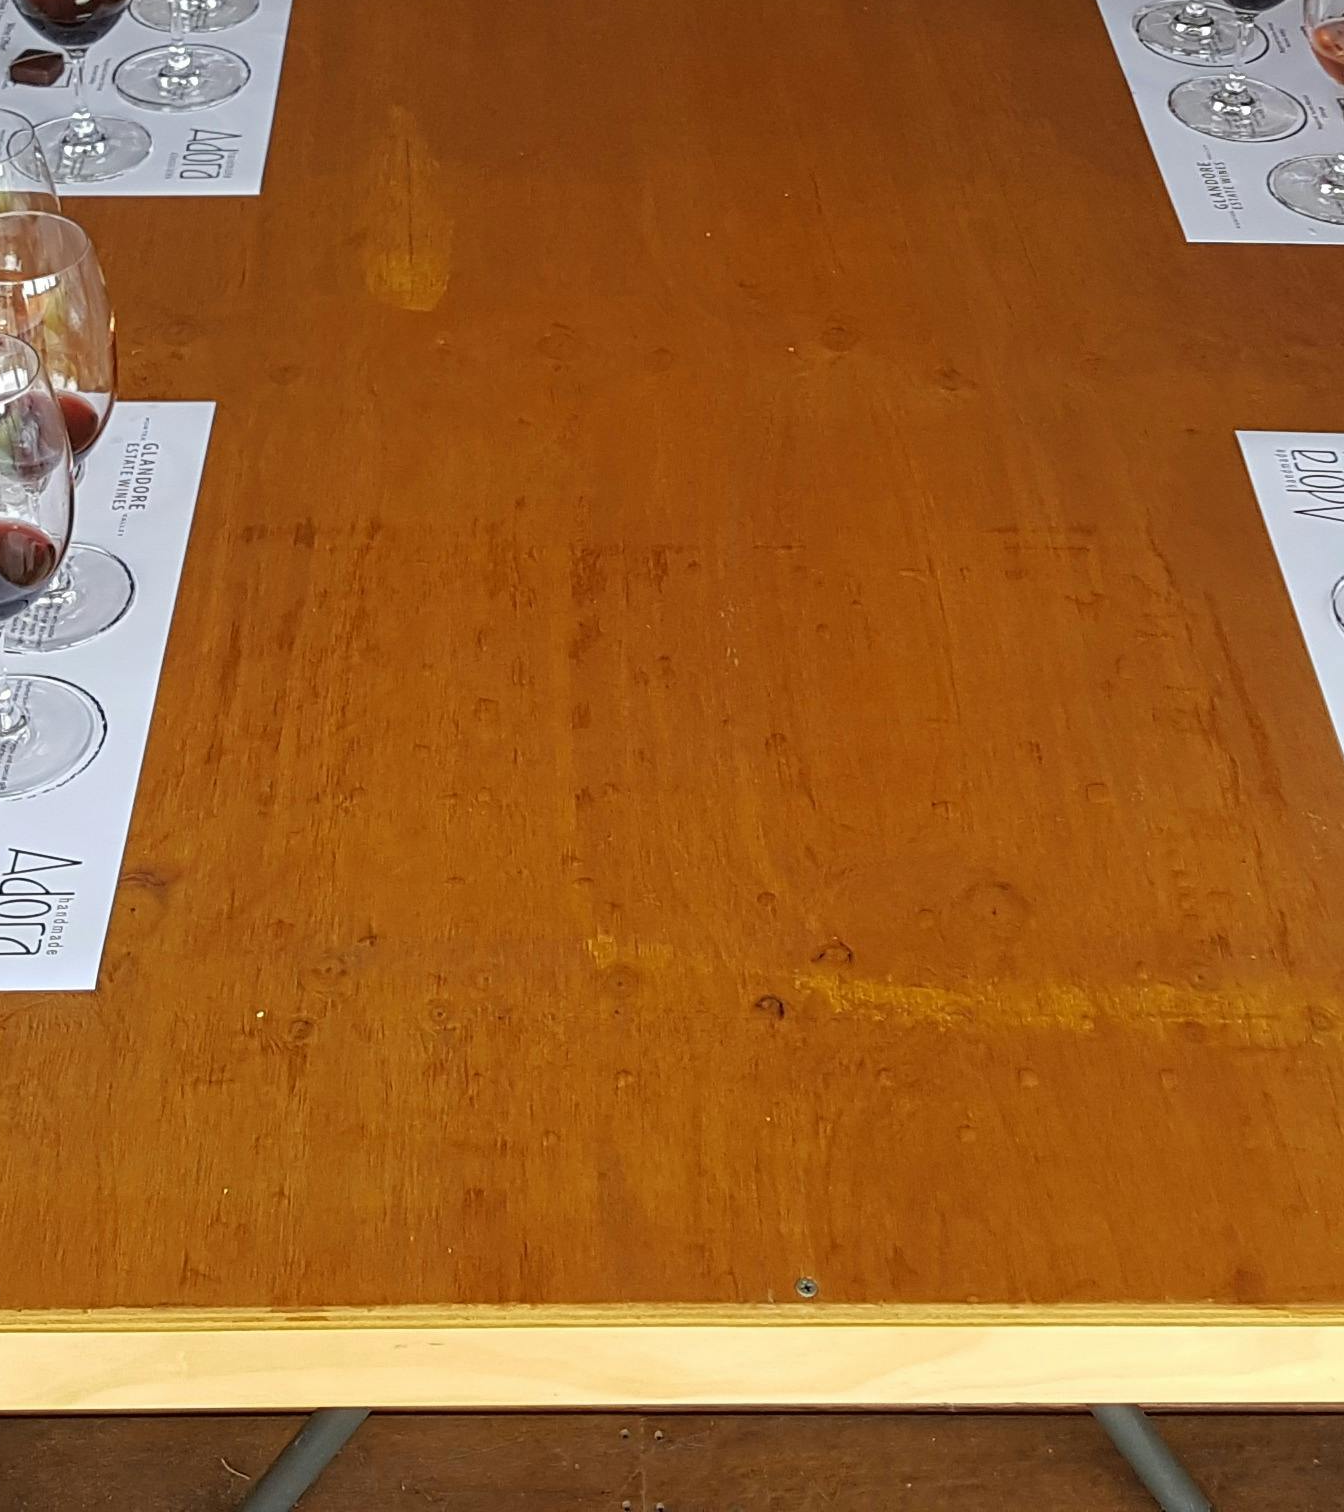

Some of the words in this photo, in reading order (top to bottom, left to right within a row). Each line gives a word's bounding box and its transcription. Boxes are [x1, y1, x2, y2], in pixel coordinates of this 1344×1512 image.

[179, 128, 243, 180] Adora
[1196, 161, 1229, 210] GLANDORE
[120, 443, 140, 476] ESTATE
[128, 443, 160, 510] GLANDORE
[112, 478, 131, 511] WINES
[46, 897, 75, 955] handmade
